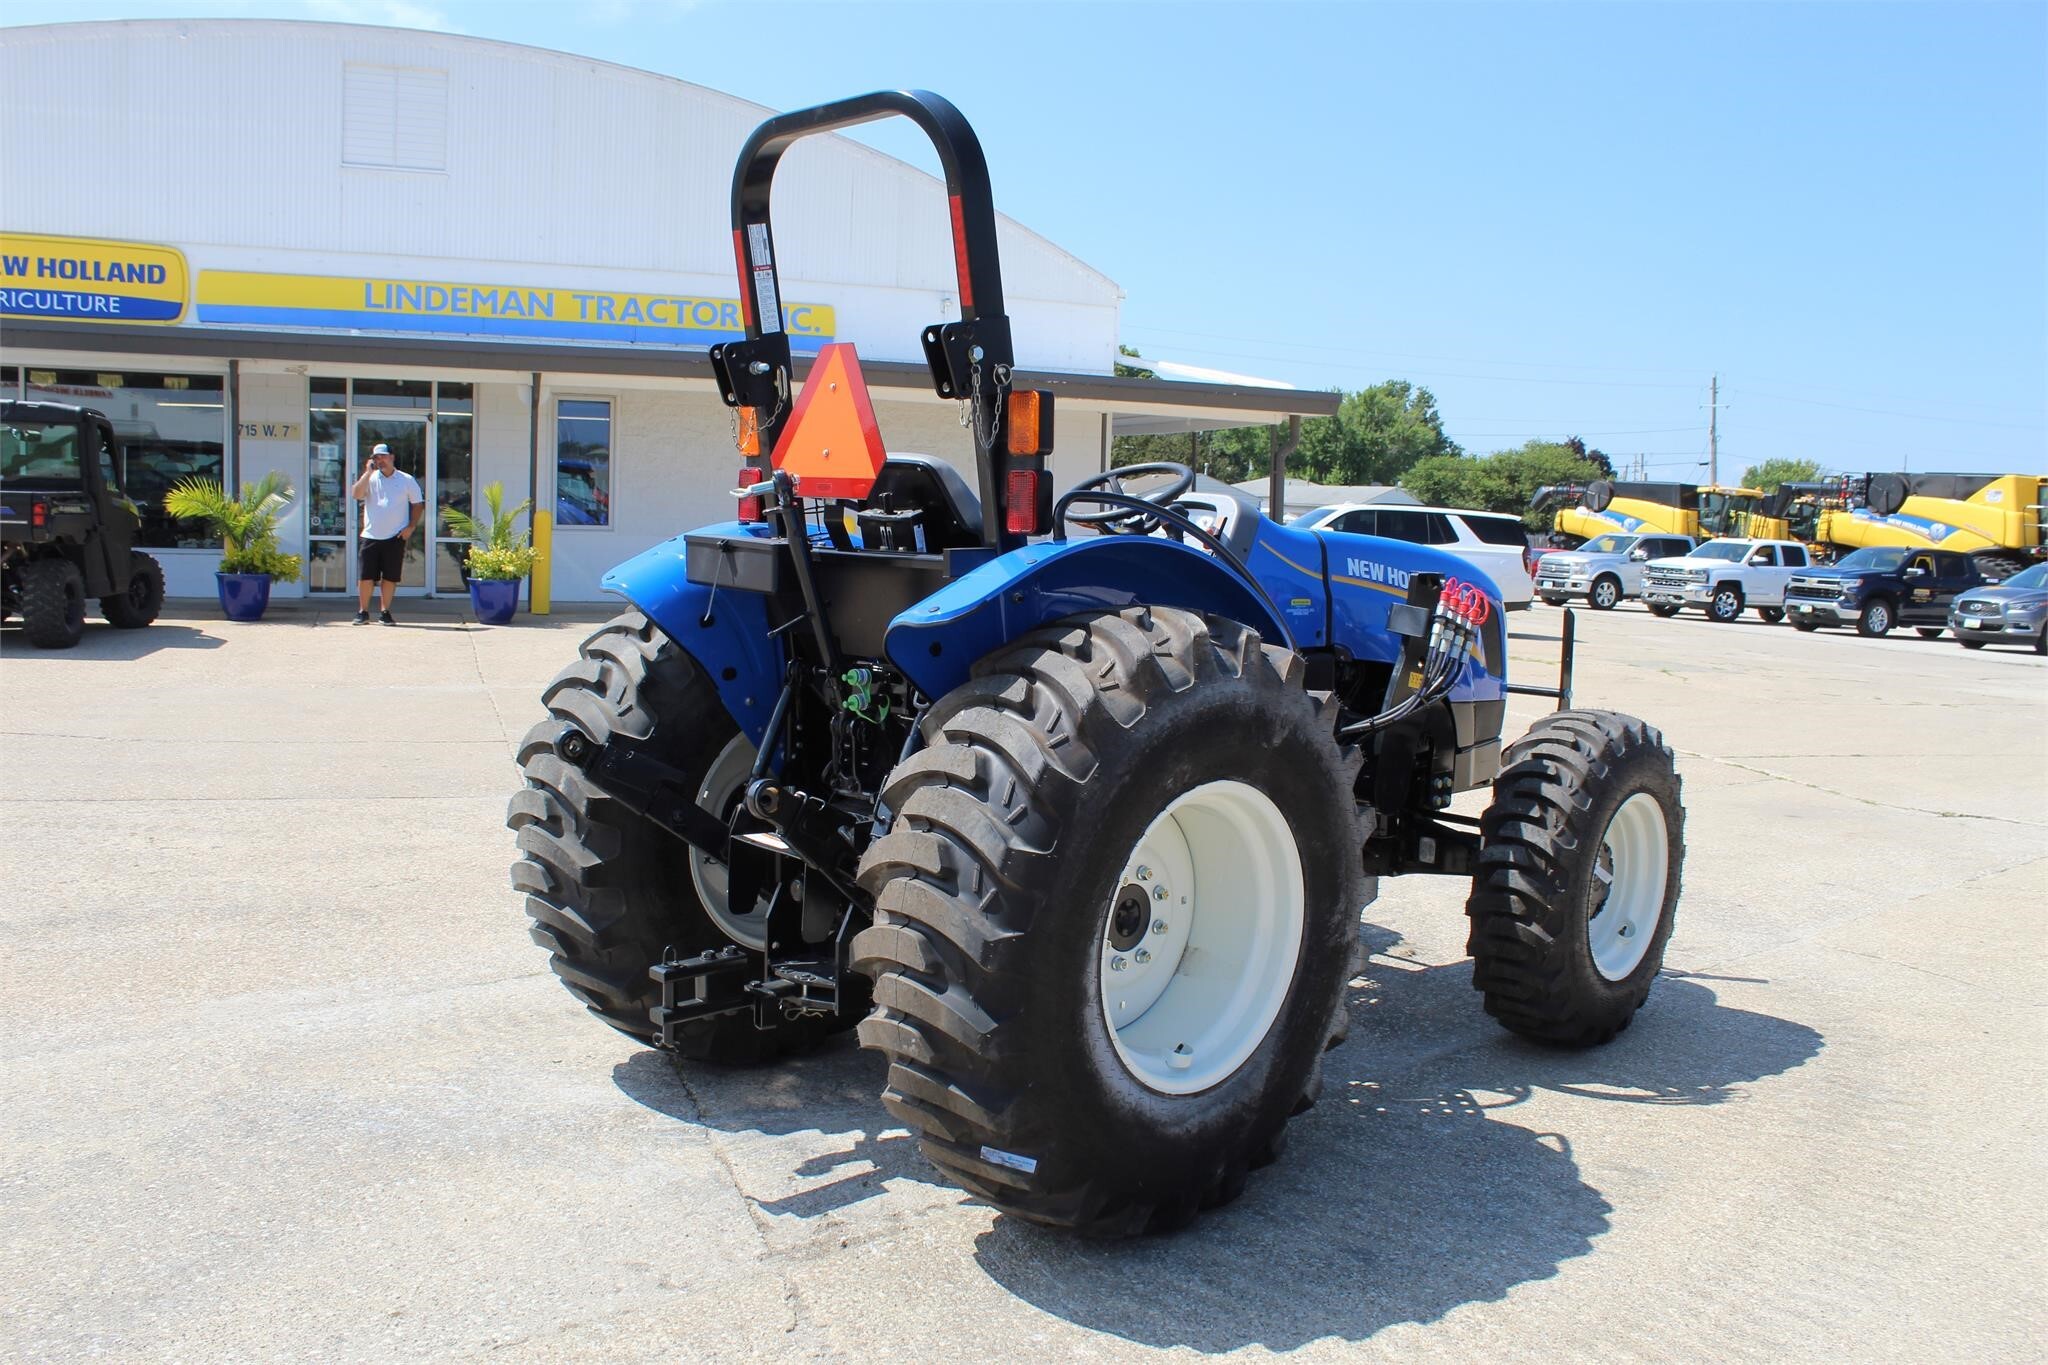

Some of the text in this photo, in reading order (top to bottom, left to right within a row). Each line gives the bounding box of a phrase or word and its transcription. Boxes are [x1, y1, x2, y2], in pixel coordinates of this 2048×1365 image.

[0, 255, 166, 284] W HOLLAND
[365, 282, 555, 318] LINDEMAN
[572, 294, 738, 328] TRACTOR
[262, 424, 277, 438] W.
[1346, 557, 1409, 589] NEW HO
